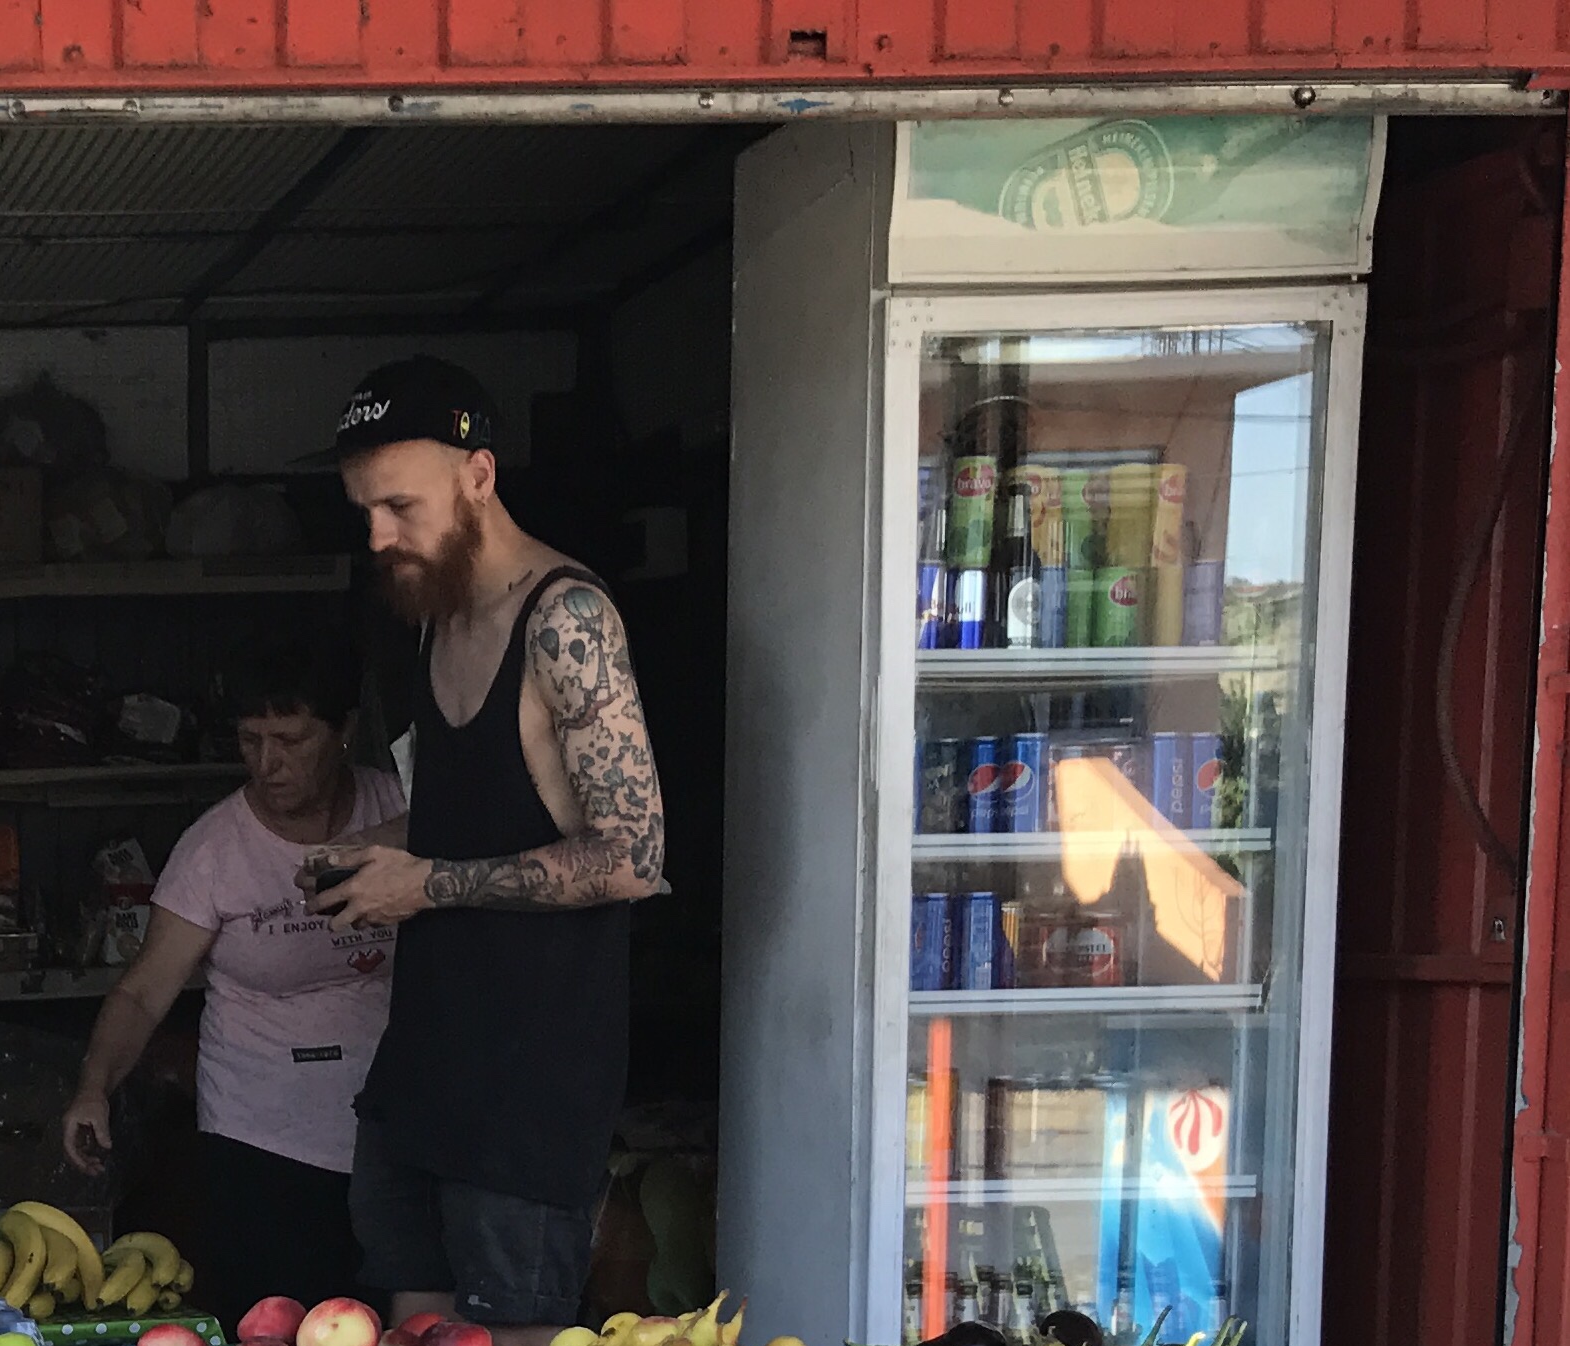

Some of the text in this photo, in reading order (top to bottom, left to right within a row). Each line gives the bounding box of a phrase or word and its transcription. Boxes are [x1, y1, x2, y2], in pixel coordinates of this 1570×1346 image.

[956, 477, 993, 491] bravo
[268, 920, 324, 935] I ENJOY
[331, 928, 393, 947] WITH YOU
